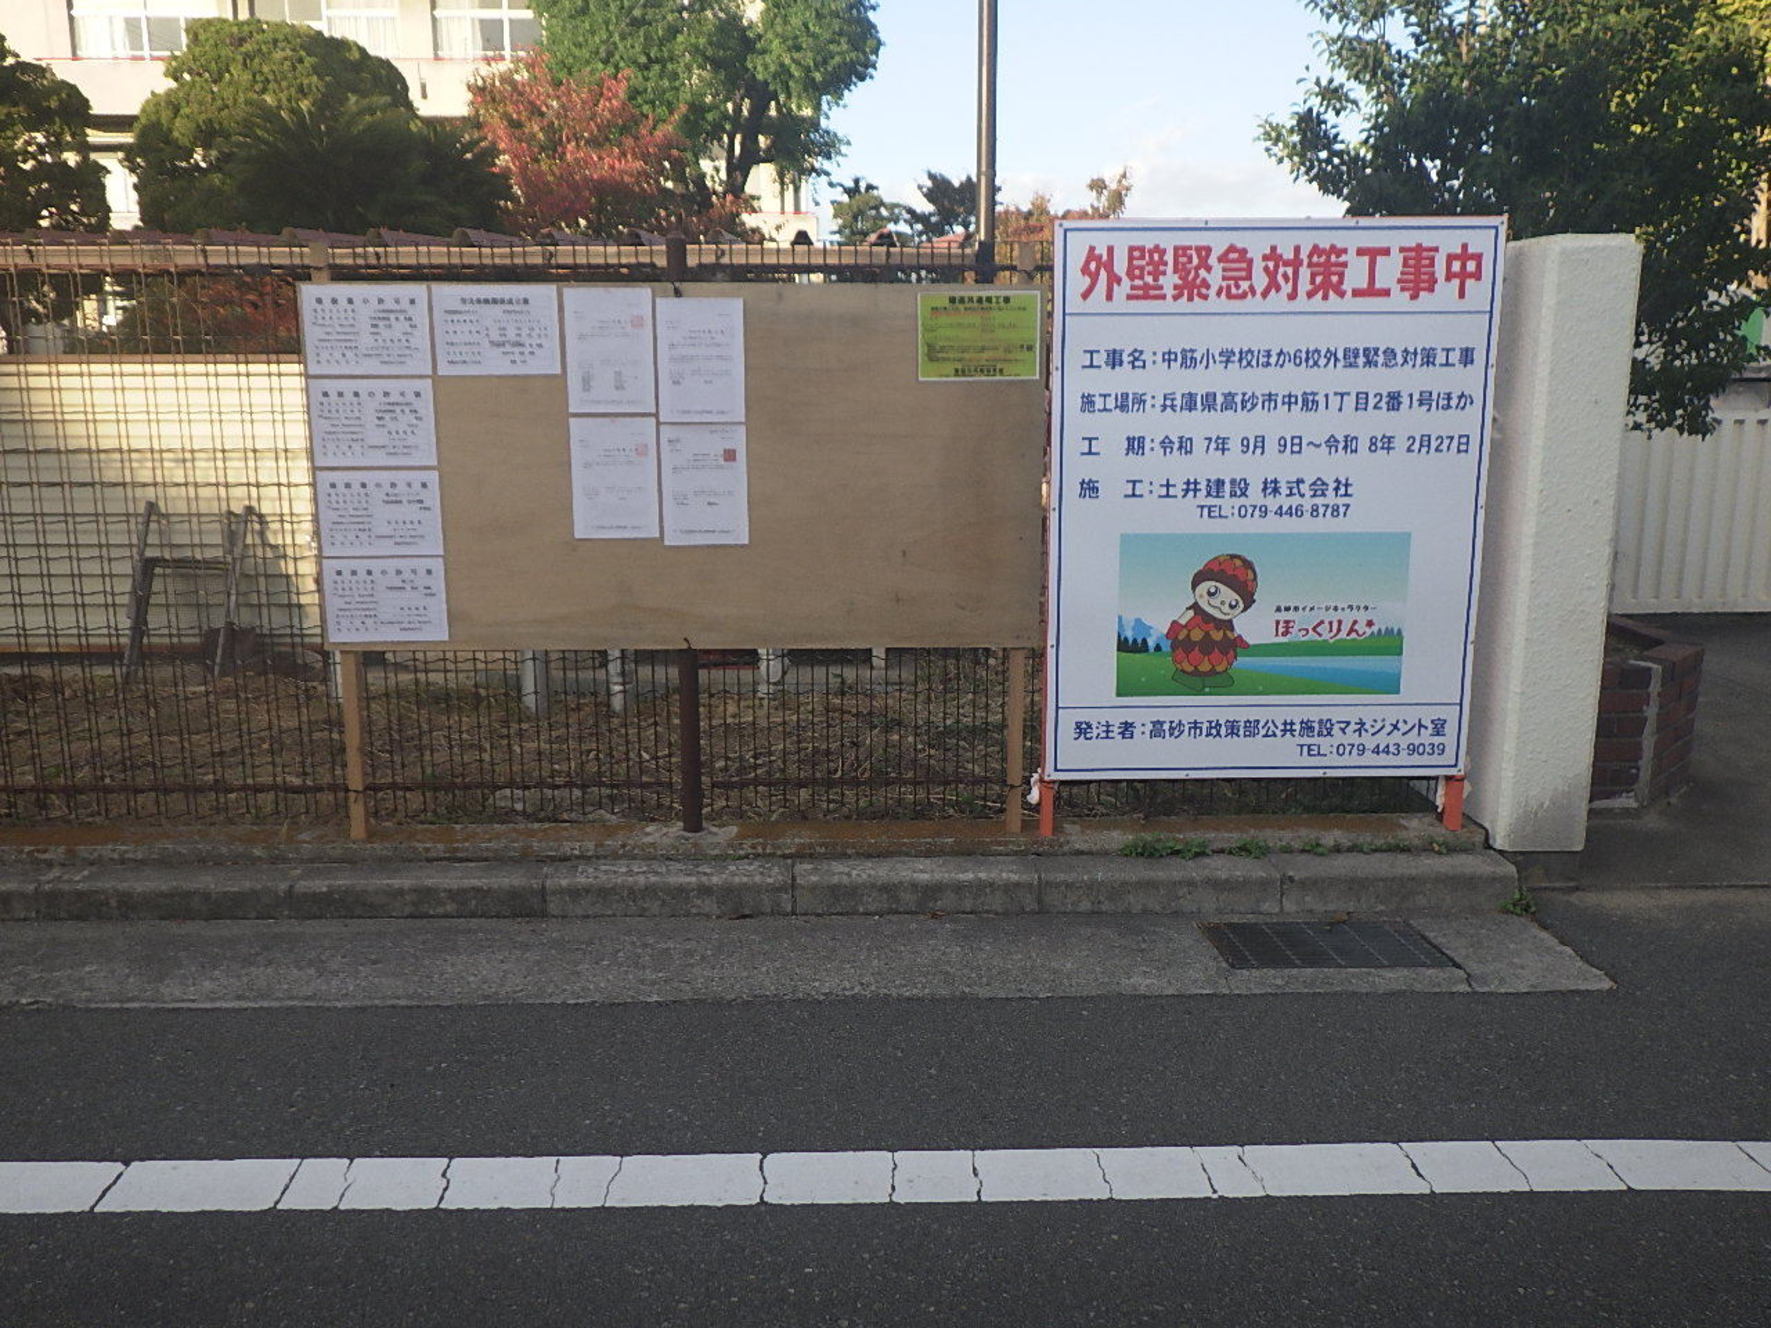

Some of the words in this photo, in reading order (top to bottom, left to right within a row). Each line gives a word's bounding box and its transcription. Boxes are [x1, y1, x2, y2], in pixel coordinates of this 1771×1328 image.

[1079, 242, 1484, 302] 外壁緊急対策工事中
[1081, 346, 1476, 370] 工事名：中筋小学校ほか6校外壁緊急対策工事
[1080, 390, 1474, 413] 施工場所：兵庫県高砂市中筋1丁目2番1号ほか
[1203, 434, 1231, 456] 7年
[1240, 434, 1266, 456] 9月
[1368, 433, 1396, 455] 8年
[1405, 433, 1470, 455] 2月27日
[1261, 476, 1353, 499] 株式会社
[1196, 503, 1351, 519] TEL：079-446-8787
[1073, 717, 1447, 741] 発注者：高砂市政策部公共施設マネジメント室
[1296, 742, 1446, 758] TEL：079-443-9039
